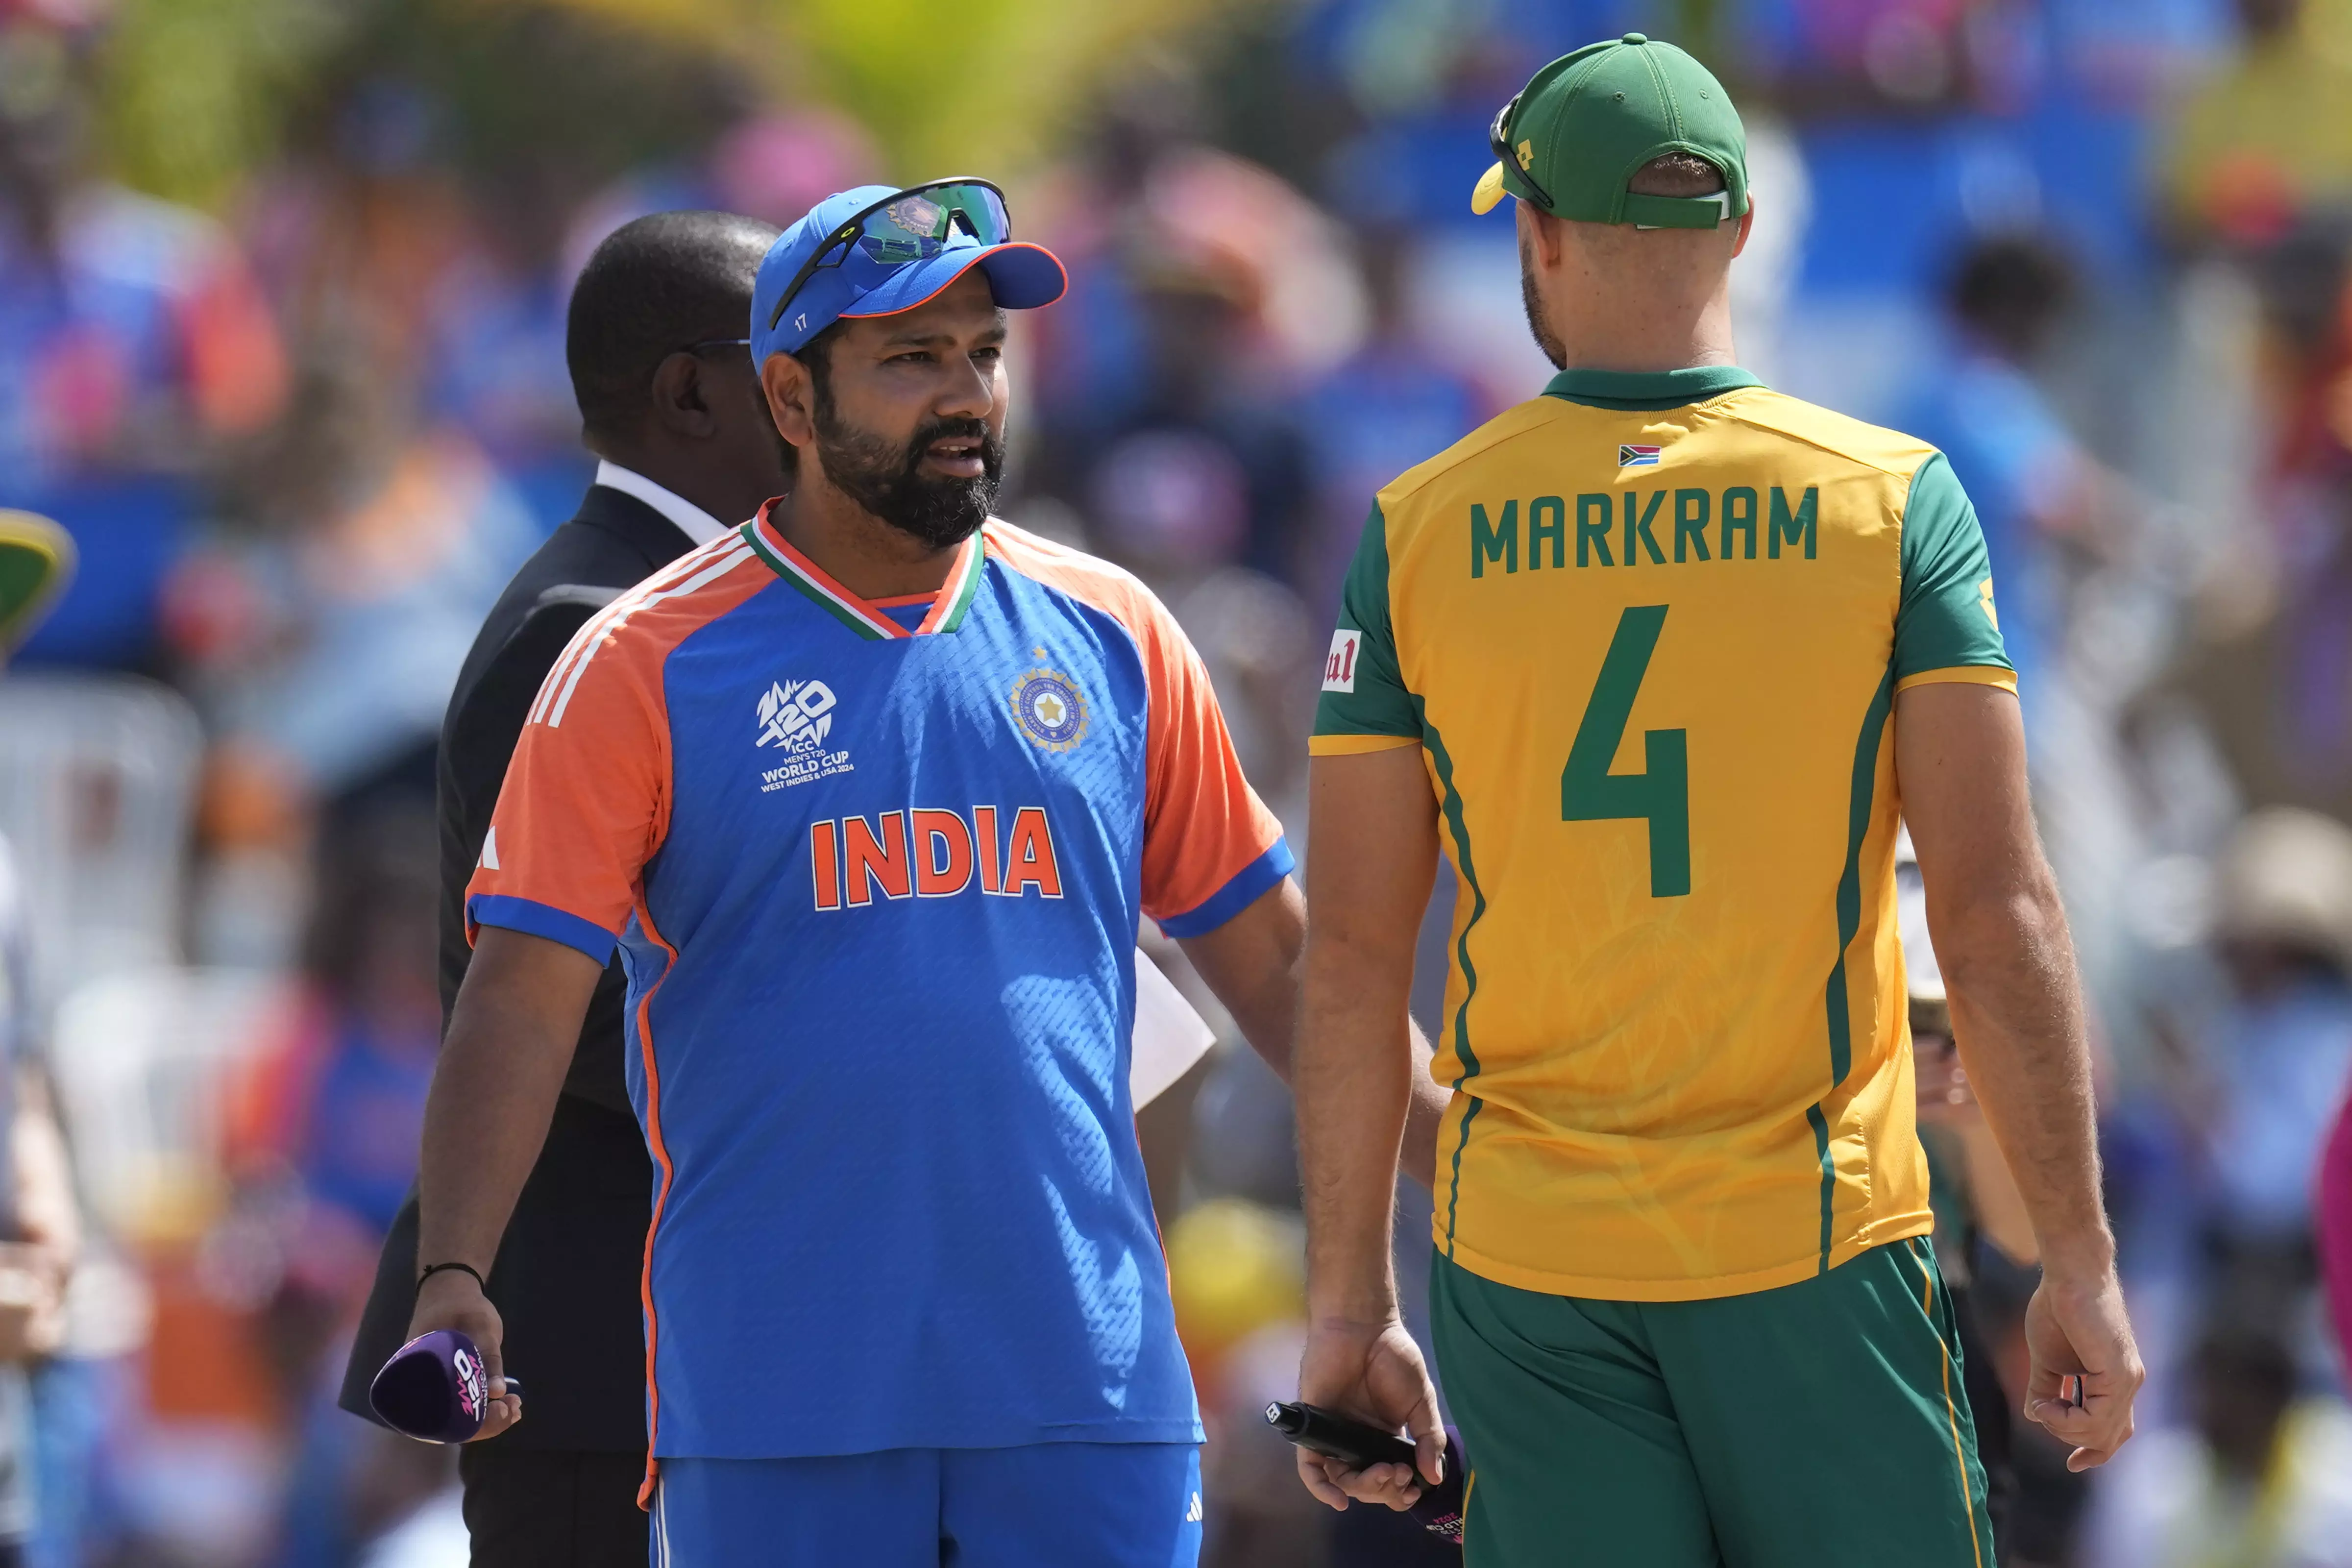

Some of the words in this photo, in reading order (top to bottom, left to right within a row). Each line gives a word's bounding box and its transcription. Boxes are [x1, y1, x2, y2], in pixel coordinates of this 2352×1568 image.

[795, 313, 807, 332] 17
[1471, 487, 1819, 579] MARKRAM
[784, 753, 810, 765] MEN'S
[811, 749, 826, 759] T20
[791, 740, 814, 754] ICC
[1561, 604, 1690, 898] 4
[761, 760, 819, 784] WORLD
[821, 751, 849, 767] CUP
[761, 781, 785, 793] WEST
[786, 774, 814, 787] INDIES
[821, 766, 837, 777] USA
[837, 763, 855, 773] 2024
[810, 804, 1064, 911] INDIA
